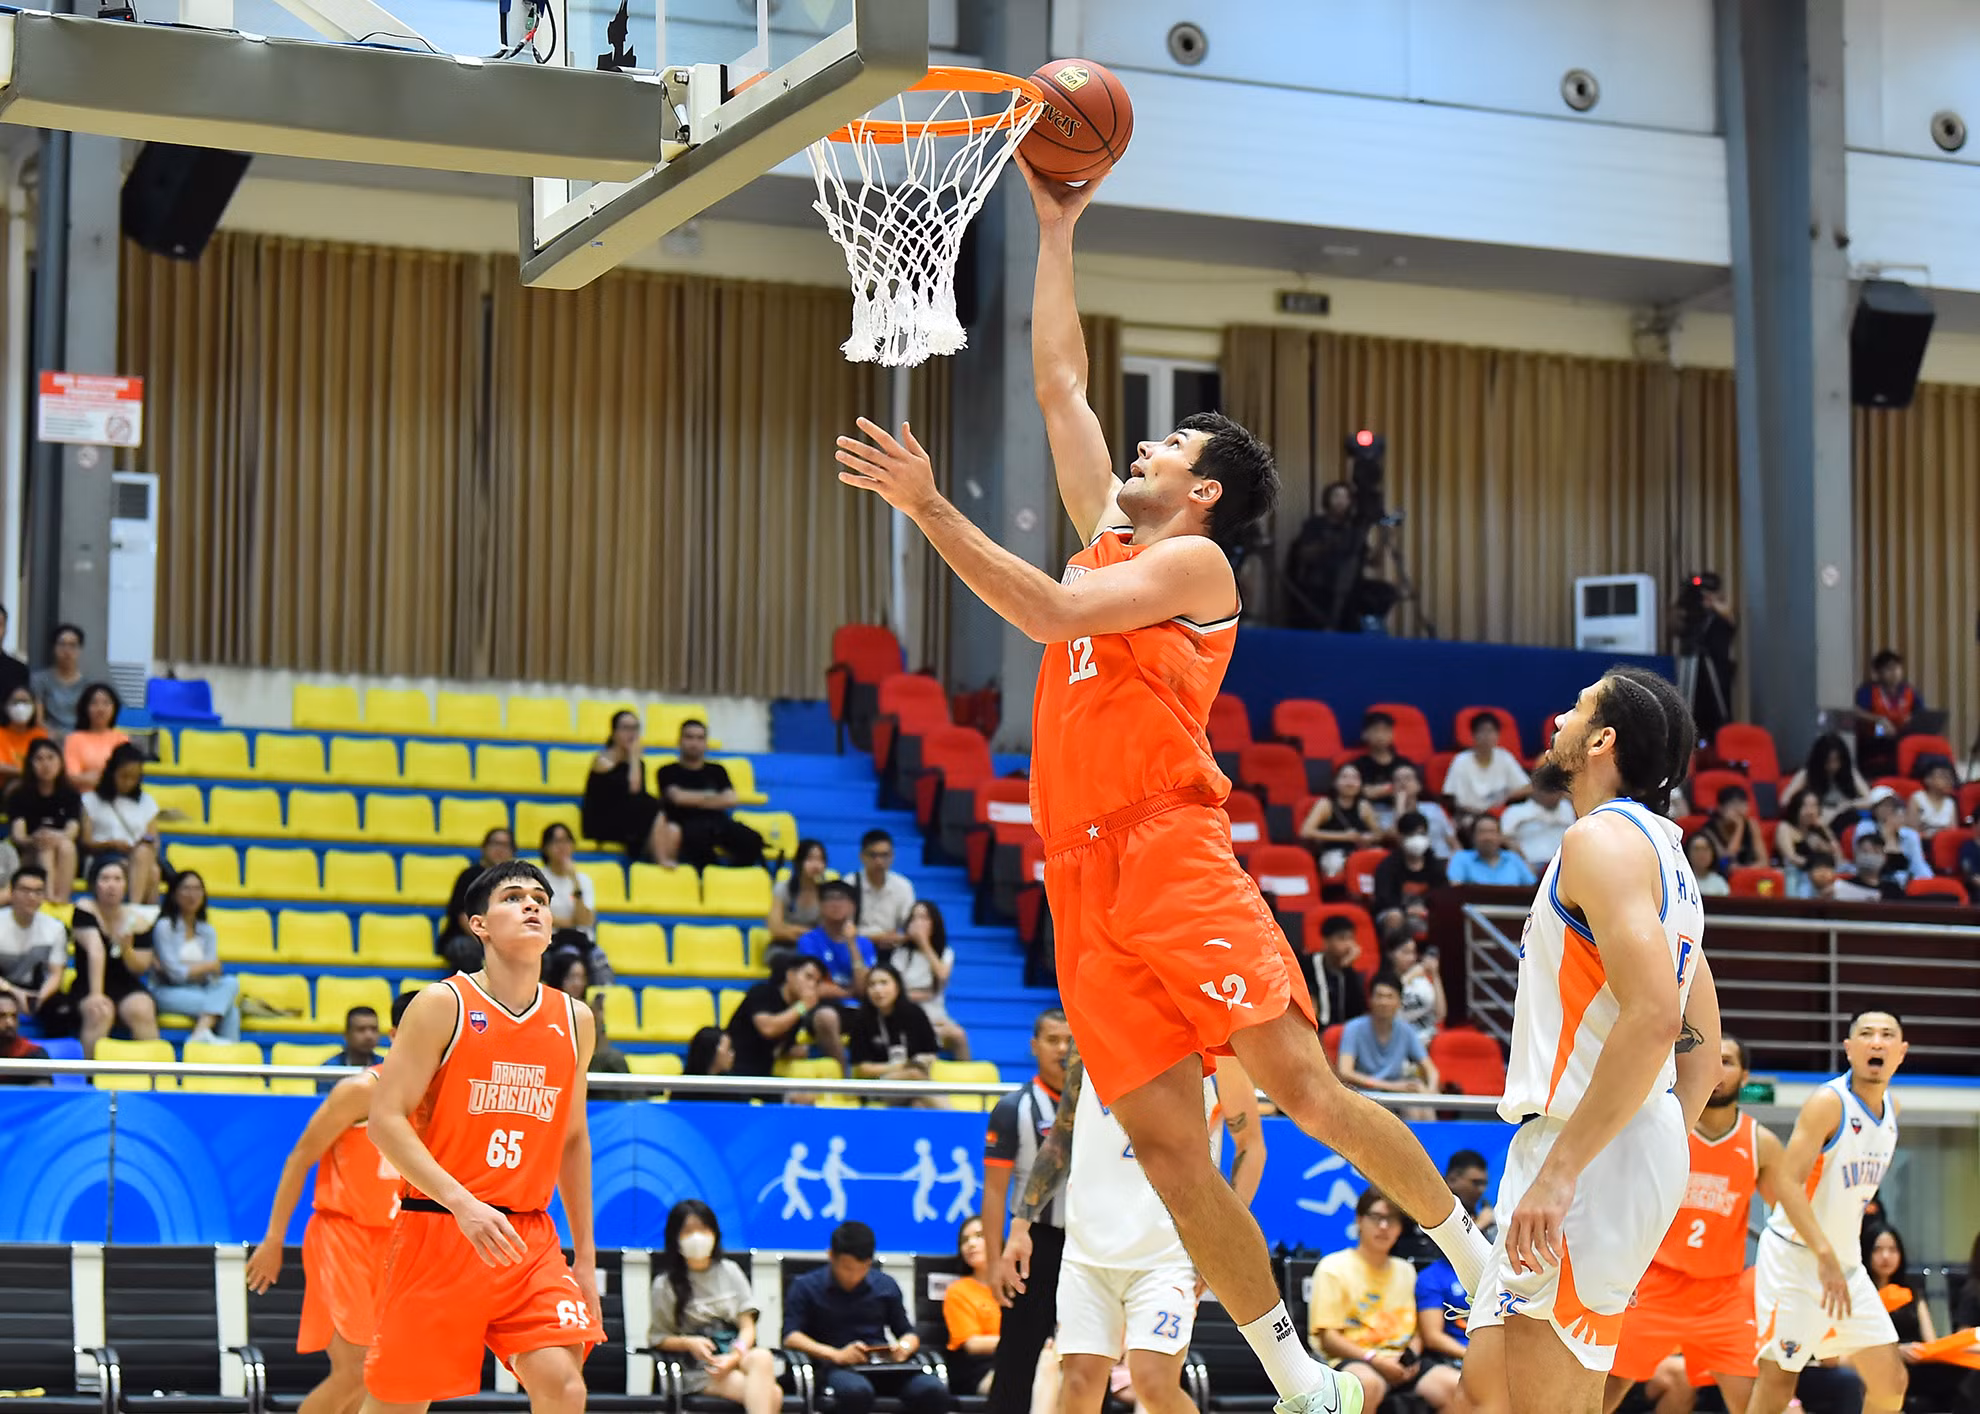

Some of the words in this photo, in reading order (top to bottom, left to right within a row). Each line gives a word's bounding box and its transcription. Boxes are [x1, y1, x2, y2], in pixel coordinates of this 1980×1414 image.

[1067, 636, 1098, 685] 12
[1200, 974, 1253, 1012] 12
[493, 1064, 545, 1088] DANANG
[470, 1082, 557, 1120] DRAGONS
[486, 1129, 524, 1169] 65
[1688, 1219, 1706, 1249] 2
[1153, 1311, 1181, 1339] 23
[1276, 1325, 1295, 1342] HOOPS
